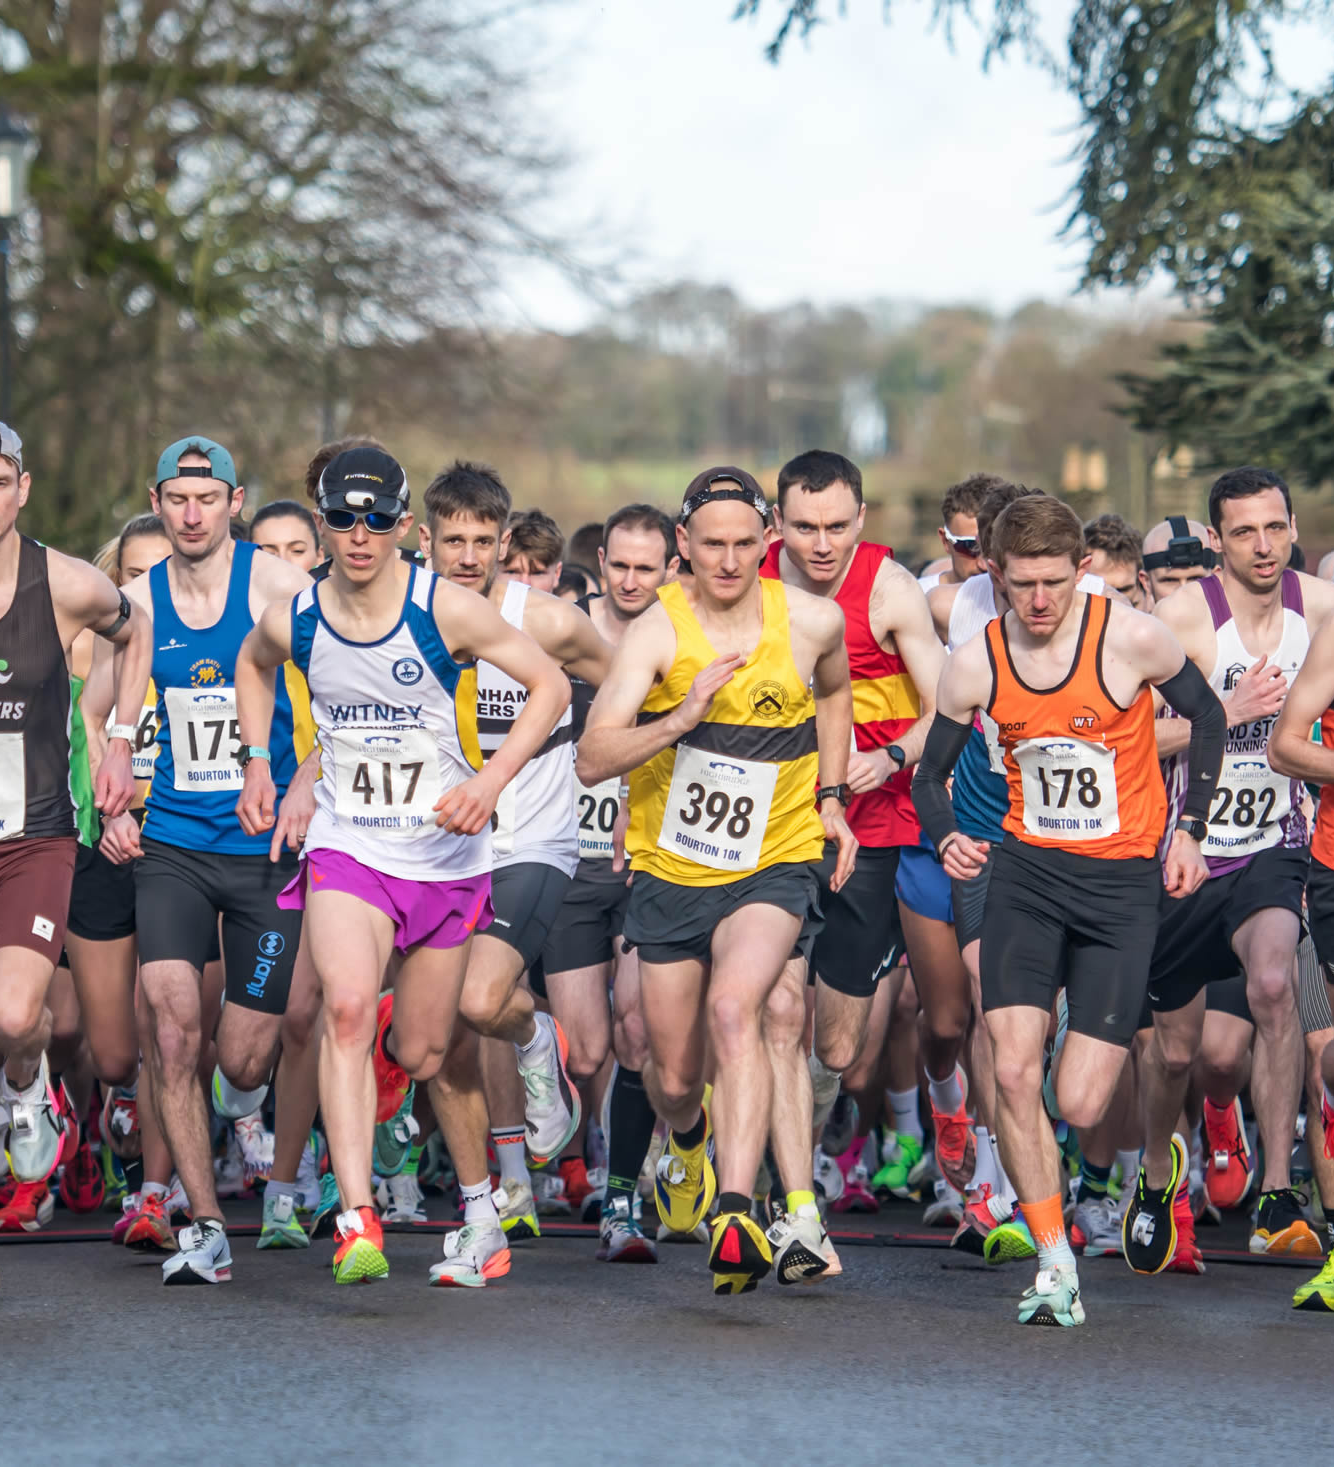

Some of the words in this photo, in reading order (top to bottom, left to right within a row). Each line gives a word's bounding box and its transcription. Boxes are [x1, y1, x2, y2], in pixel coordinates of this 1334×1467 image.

[328, 703, 422, 721] WITNEY
[1073, 717, 1094, 728] WT
[1001, 721, 1028, 732] soar
[187, 719, 240, 761] 175
[1225, 739, 1267, 754] UNNING
[188, 770, 231, 781] BOURTON
[352, 761, 424, 805] 417
[1038, 766, 1102, 809] 178
[679, 782, 755, 840] 398
[1208, 787, 1276, 829] 282
[352, 816, 401, 828] BOURTON
[405, 815, 424, 826] 10K
[1038, 815, 1080, 829] BOURTON
[1084, 818, 1102, 829] 10K
[675, 831, 720, 857] BOURTON
[722, 848, 742, 862] 10K
[246, 956, 276, 998] janji
